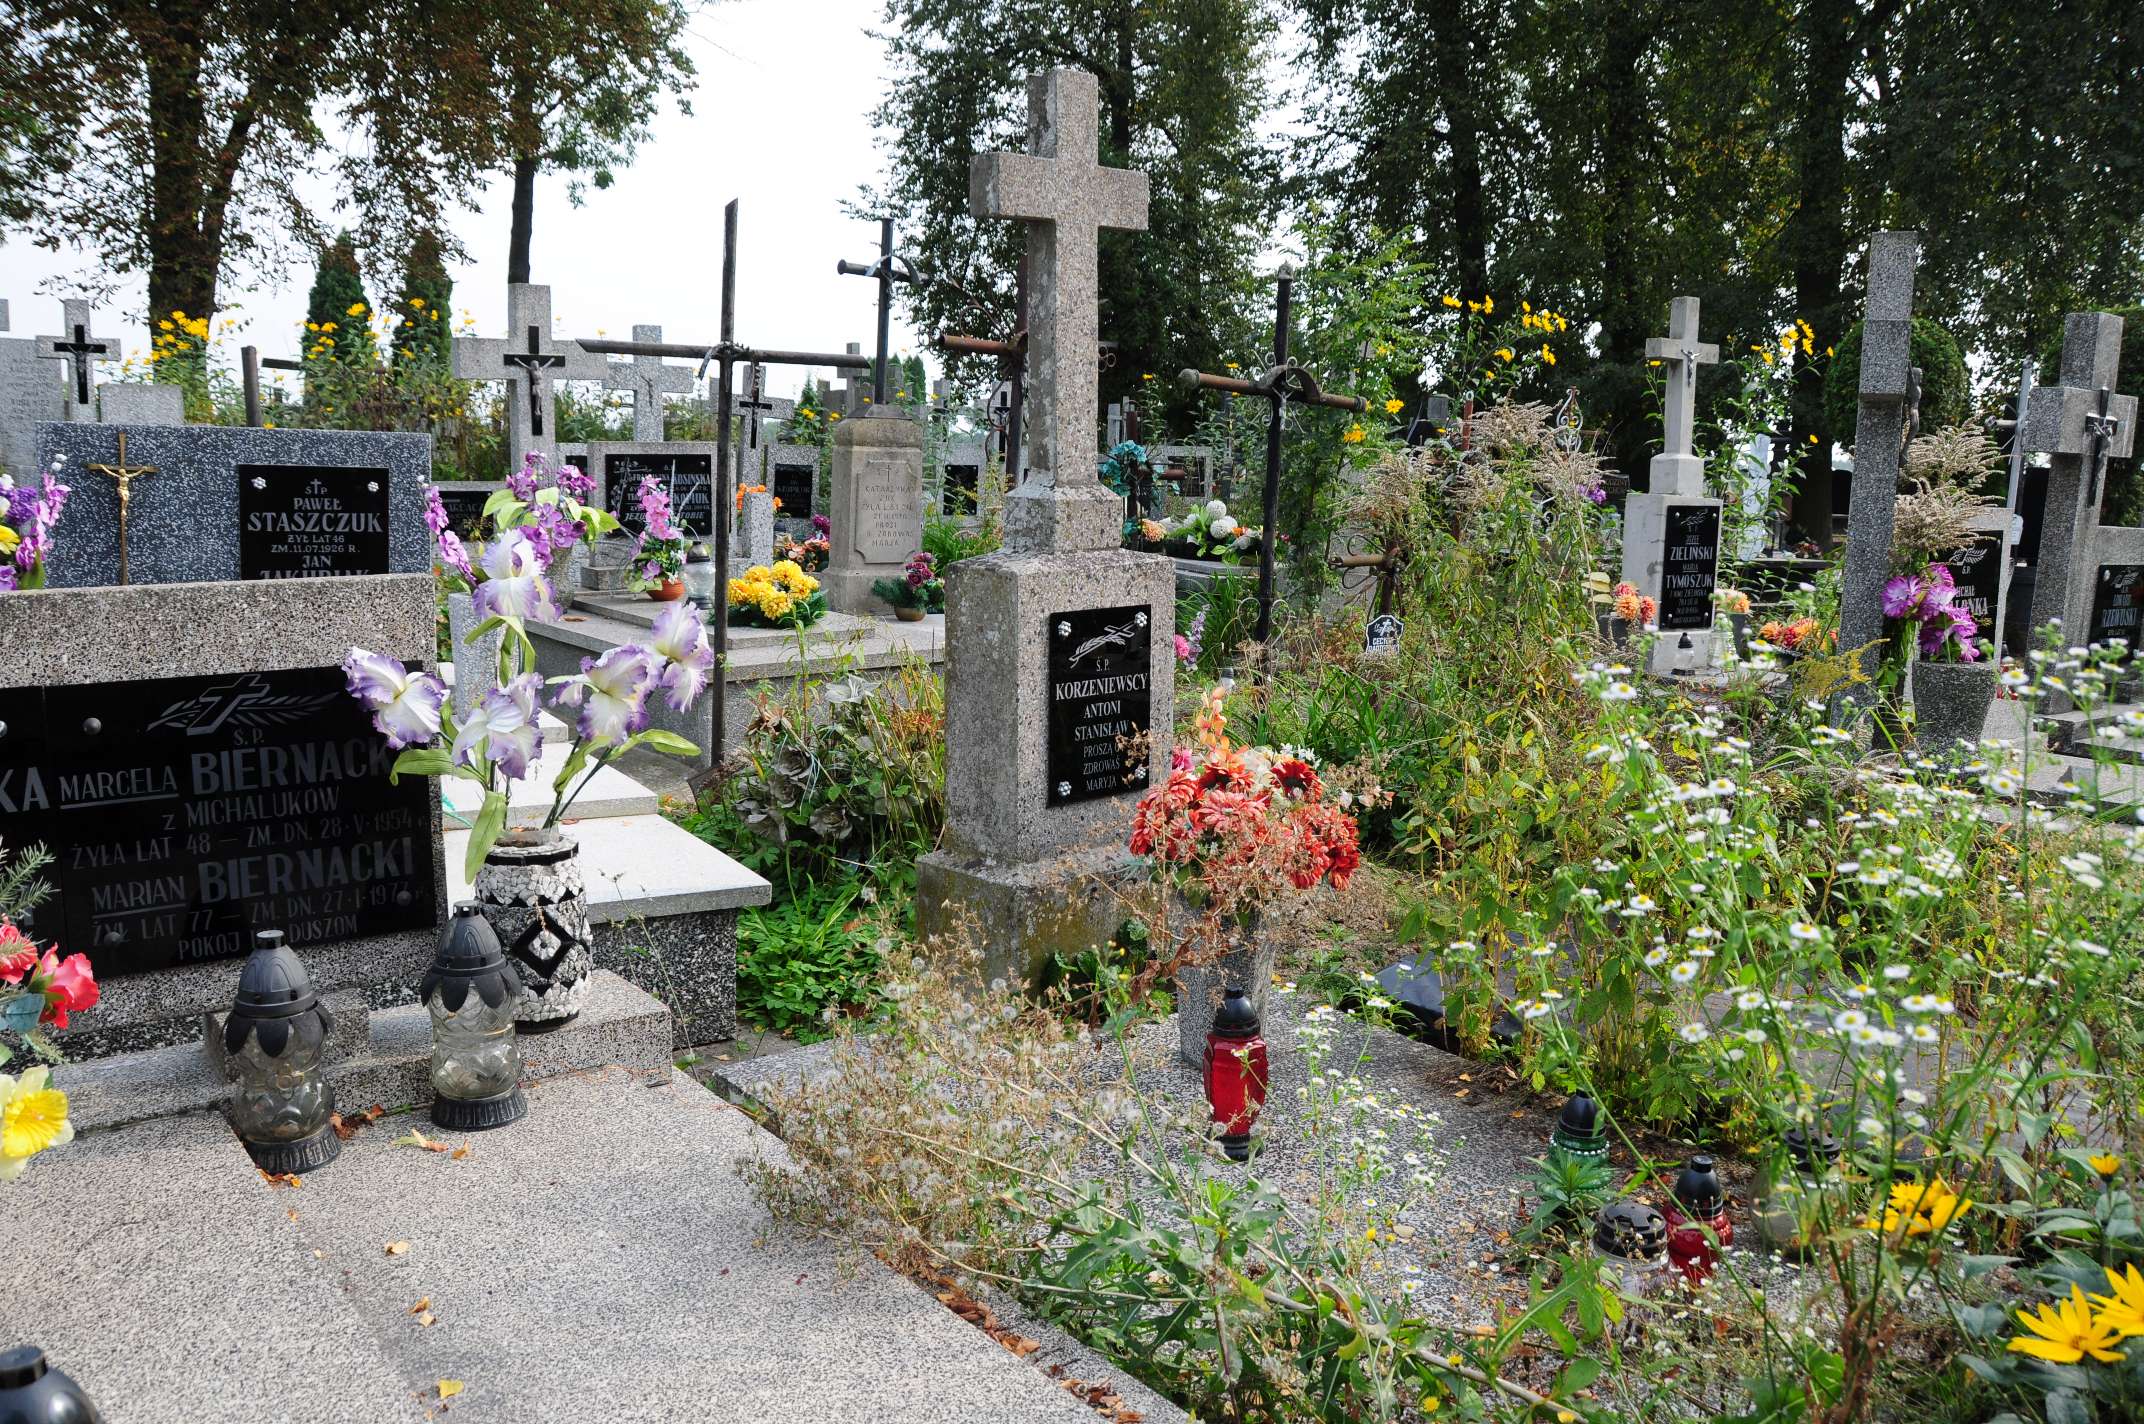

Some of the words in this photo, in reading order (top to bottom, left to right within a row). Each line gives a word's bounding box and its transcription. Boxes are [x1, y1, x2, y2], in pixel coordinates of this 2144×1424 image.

[293, 497, 343, 511] PAWEŁ
[247, 511, 383, 532] STASZCZUK
[312, 534, 330, 543] LAT
[332, 534, 345, 543] 46
[302, 555, 332, 568] JAN
[1665, 573, 1713, 589] TYMOSZUK
[1056, 673, 1148, 700] KORZENIEWSCY
[1083, 700, 1121, 719] ANTONI
[1074, 720, 1129, 741] STANISŁAW
[60, 765, 178, 803] MARCELA
[191, 737, 393, 796] BIERNACK
[1083, 755, 1120, 775] ZDROWAŚ
[1086, 775, 1117, 791] MARYJA
[72, 840, 126, 870] ŻYŁA
[134, 836, 171, 863] LAT
[185, 831, 211, 856] 48
[248, 825, 274, 849] ZM.
[283, 821, 313, 844] DN.
[91, 875, 185, 912] MARIAN
[198, 836, 414, 905] BIERNACKI
[141, 914, 176, 940] LAT
[189, 909, 214, 933] 77
[287, 897, 316, 918] DN.
[288, 912, 358, 943] DUSZOM
